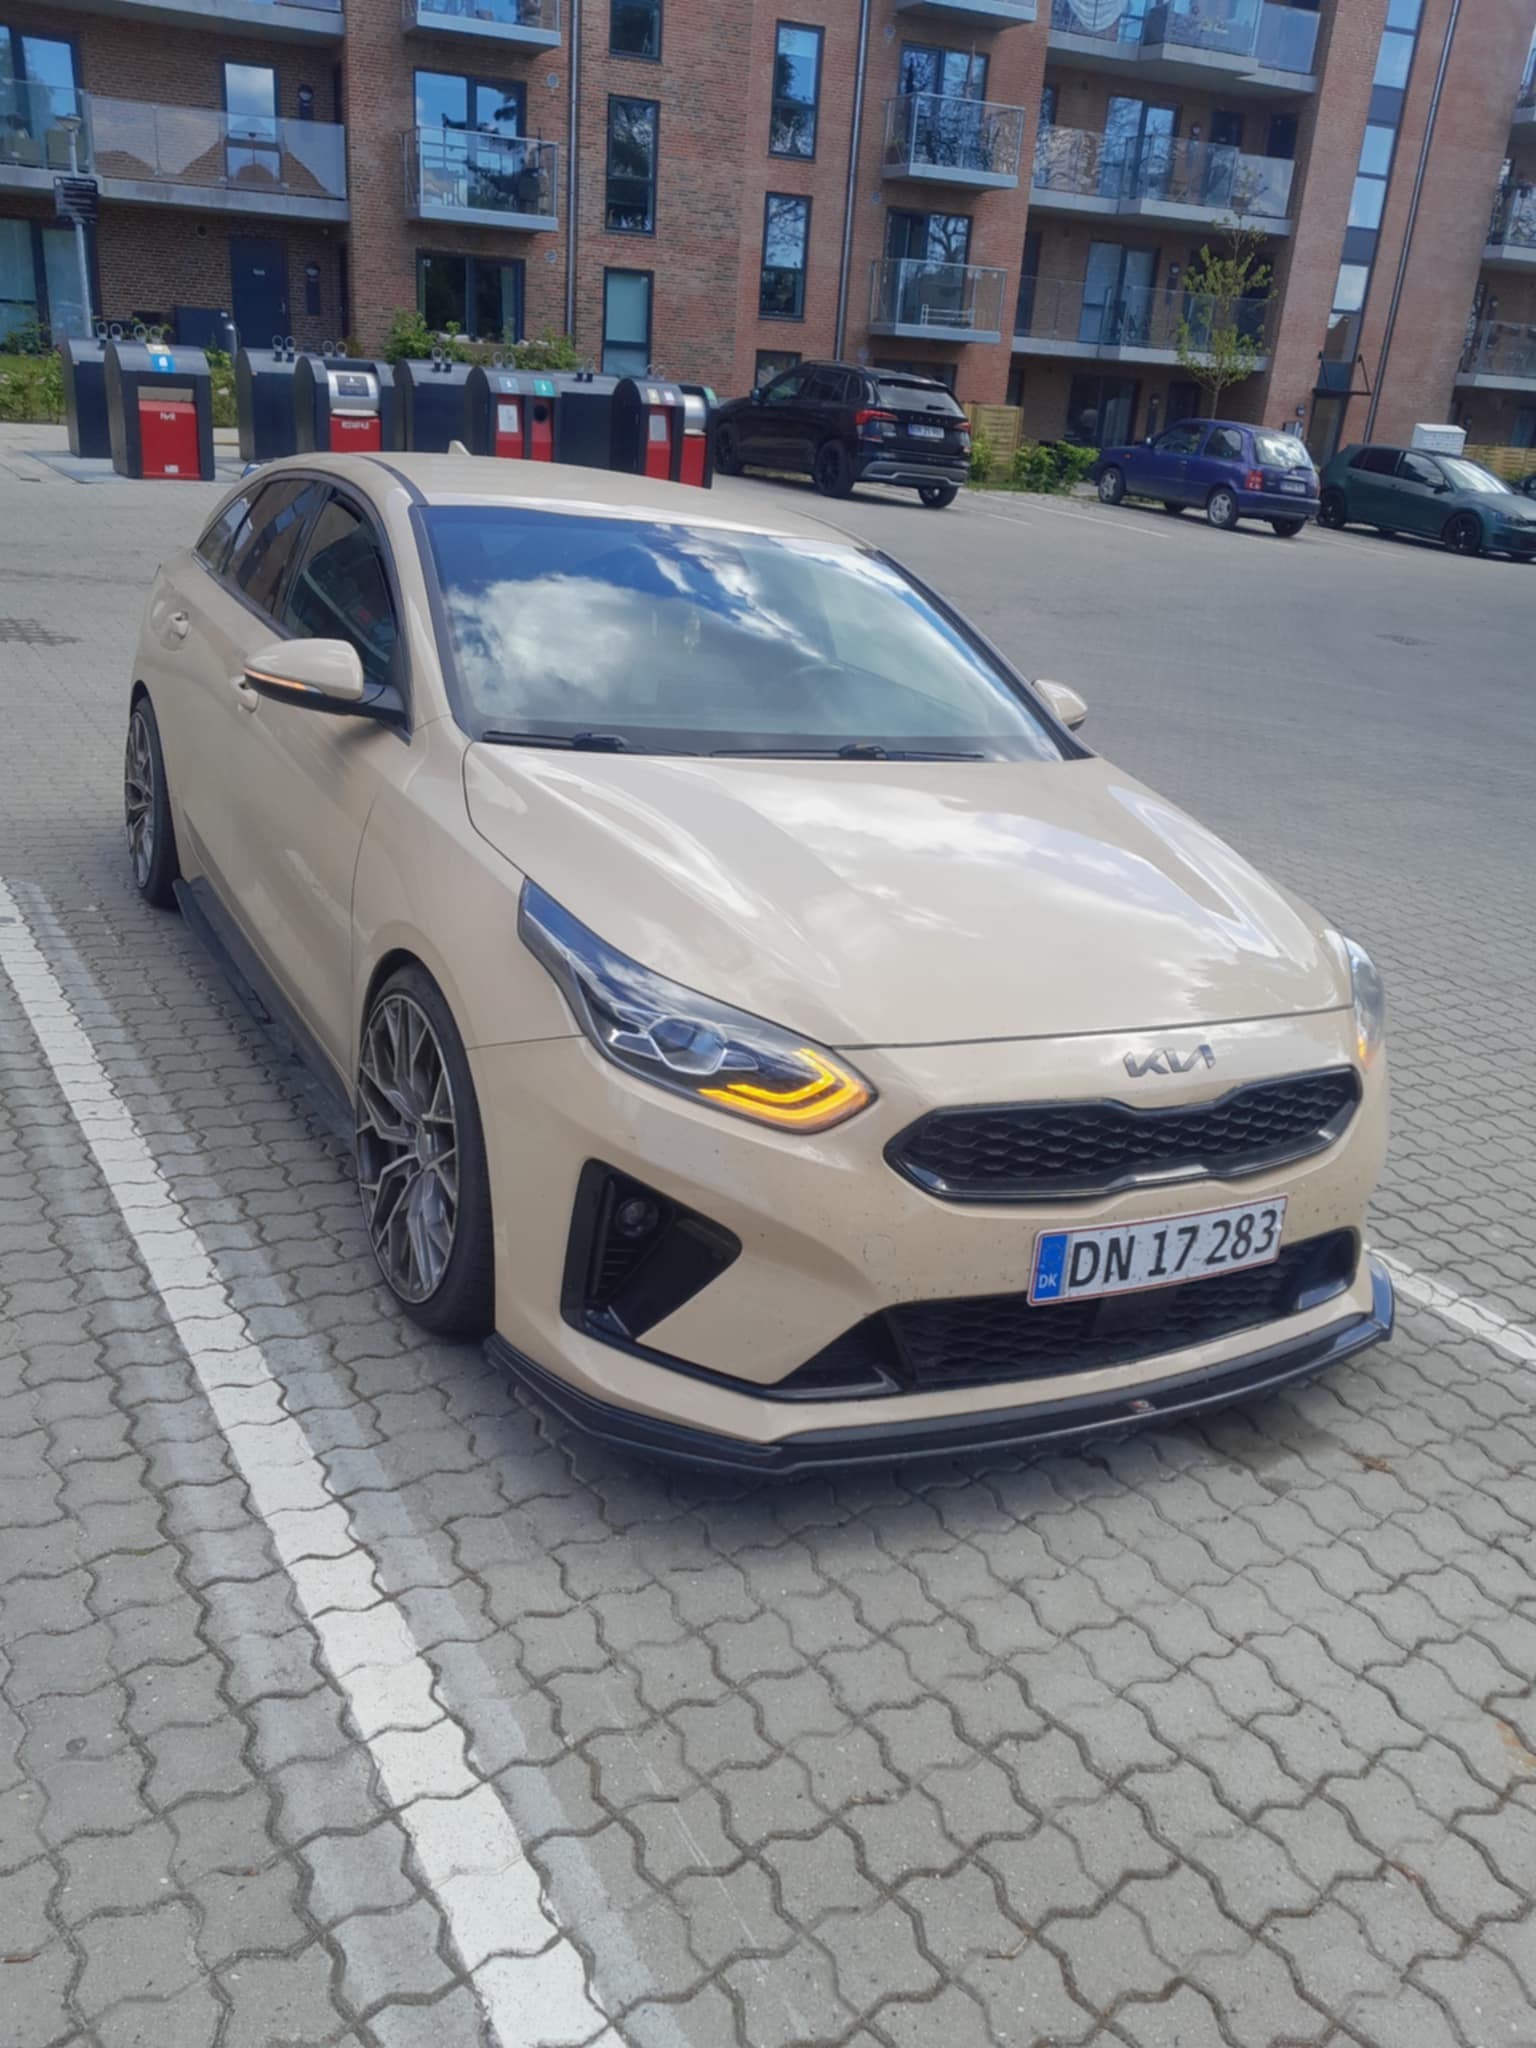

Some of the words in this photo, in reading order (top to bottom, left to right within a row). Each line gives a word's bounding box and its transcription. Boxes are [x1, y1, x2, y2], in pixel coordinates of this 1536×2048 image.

[1122, 1044, 1217, 1078] KIA
[1068, 1235, 1136, 1288] DN
[1148, 1224, 1200, 1277] 17
[1205, 1209, 1278, 1266] 283
[1038, 1273, 1058, 1289] DK
